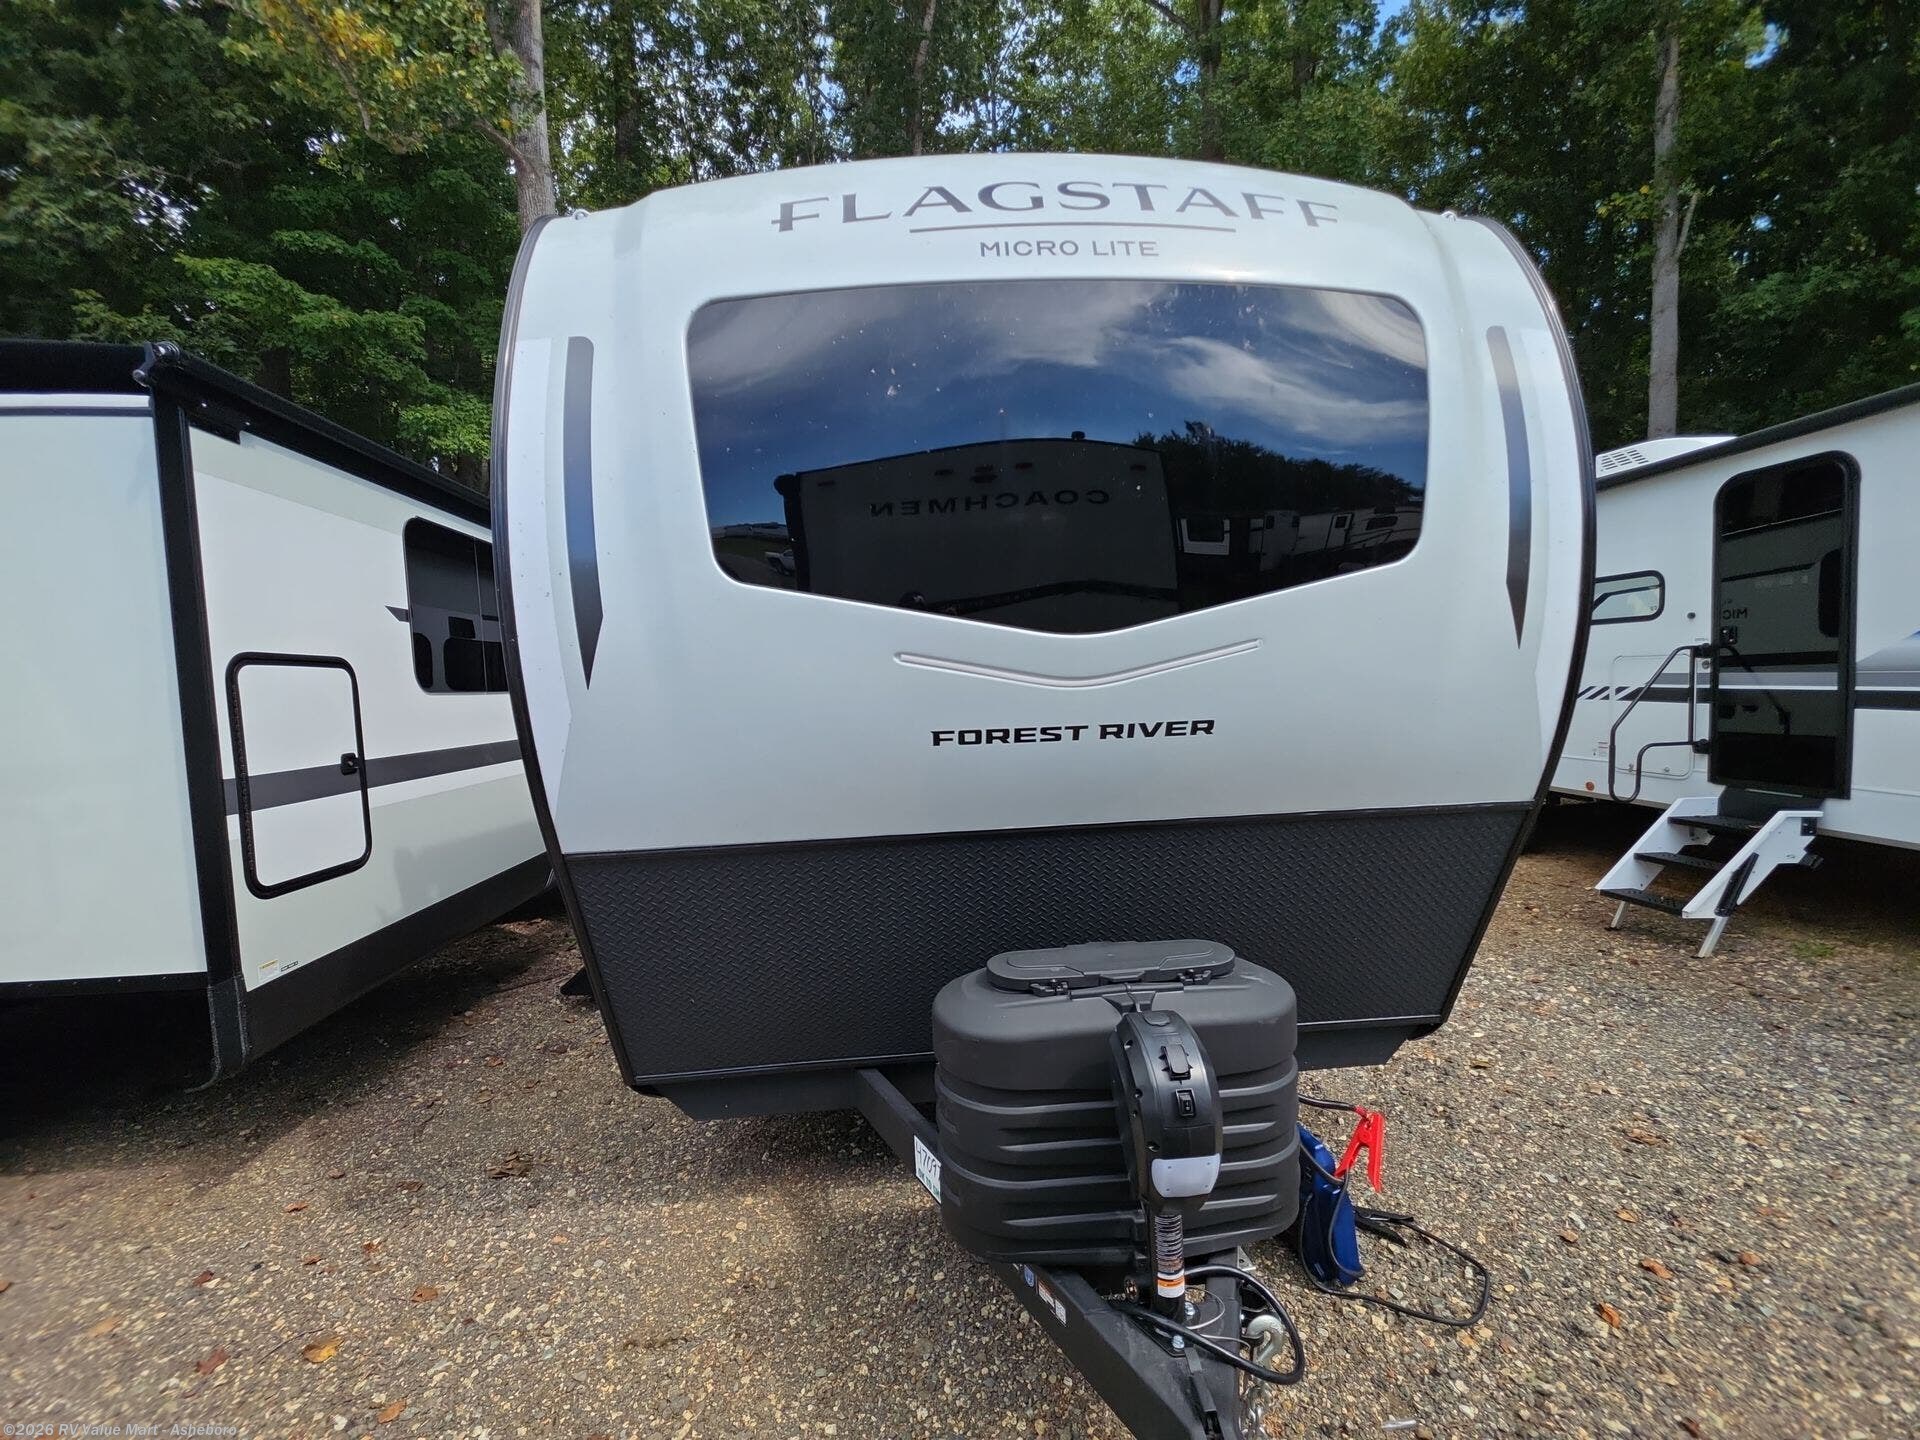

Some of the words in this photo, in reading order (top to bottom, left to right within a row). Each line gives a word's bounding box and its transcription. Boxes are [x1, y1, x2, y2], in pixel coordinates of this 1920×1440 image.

[771, 181, 1338, 232] FLAGSTAFF
[980, 240, 1079, 258] MICRO
[1093, 240, 1159, 257] LITE
[930, 725, 1089, 747] FOREST
[1098, 719, 1215, 740] RIVER
